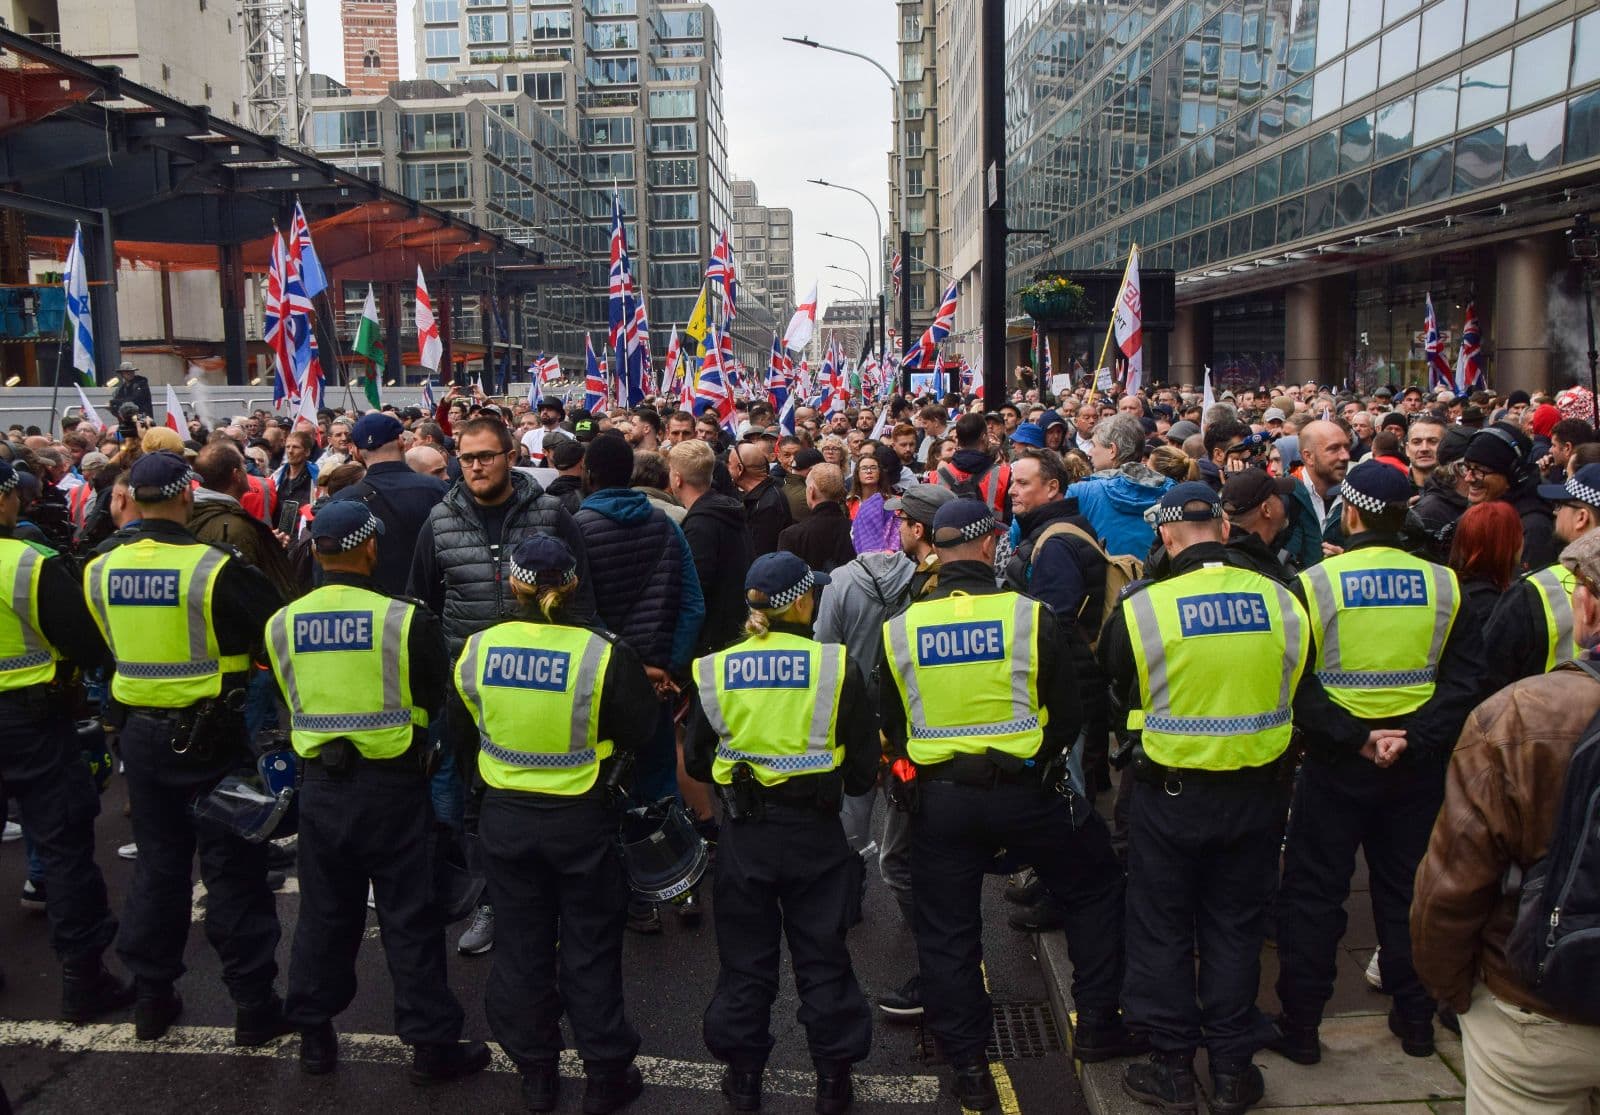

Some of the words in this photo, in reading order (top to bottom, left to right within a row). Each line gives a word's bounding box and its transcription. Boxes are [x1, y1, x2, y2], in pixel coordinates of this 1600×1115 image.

[110, 575, 176, 599] POLICE
[1345, 575, 1424, 600] POLICE
[1182, 599, 1265, 629] POLICE
[296, 617, 369, 646] POLICE
[921, 627, 1000, 658] POLICE
[487, 652, 565, 684] POLICE
[727, 655, 806, 684] POLICE
[661, 880, 689, 899] POLICE
